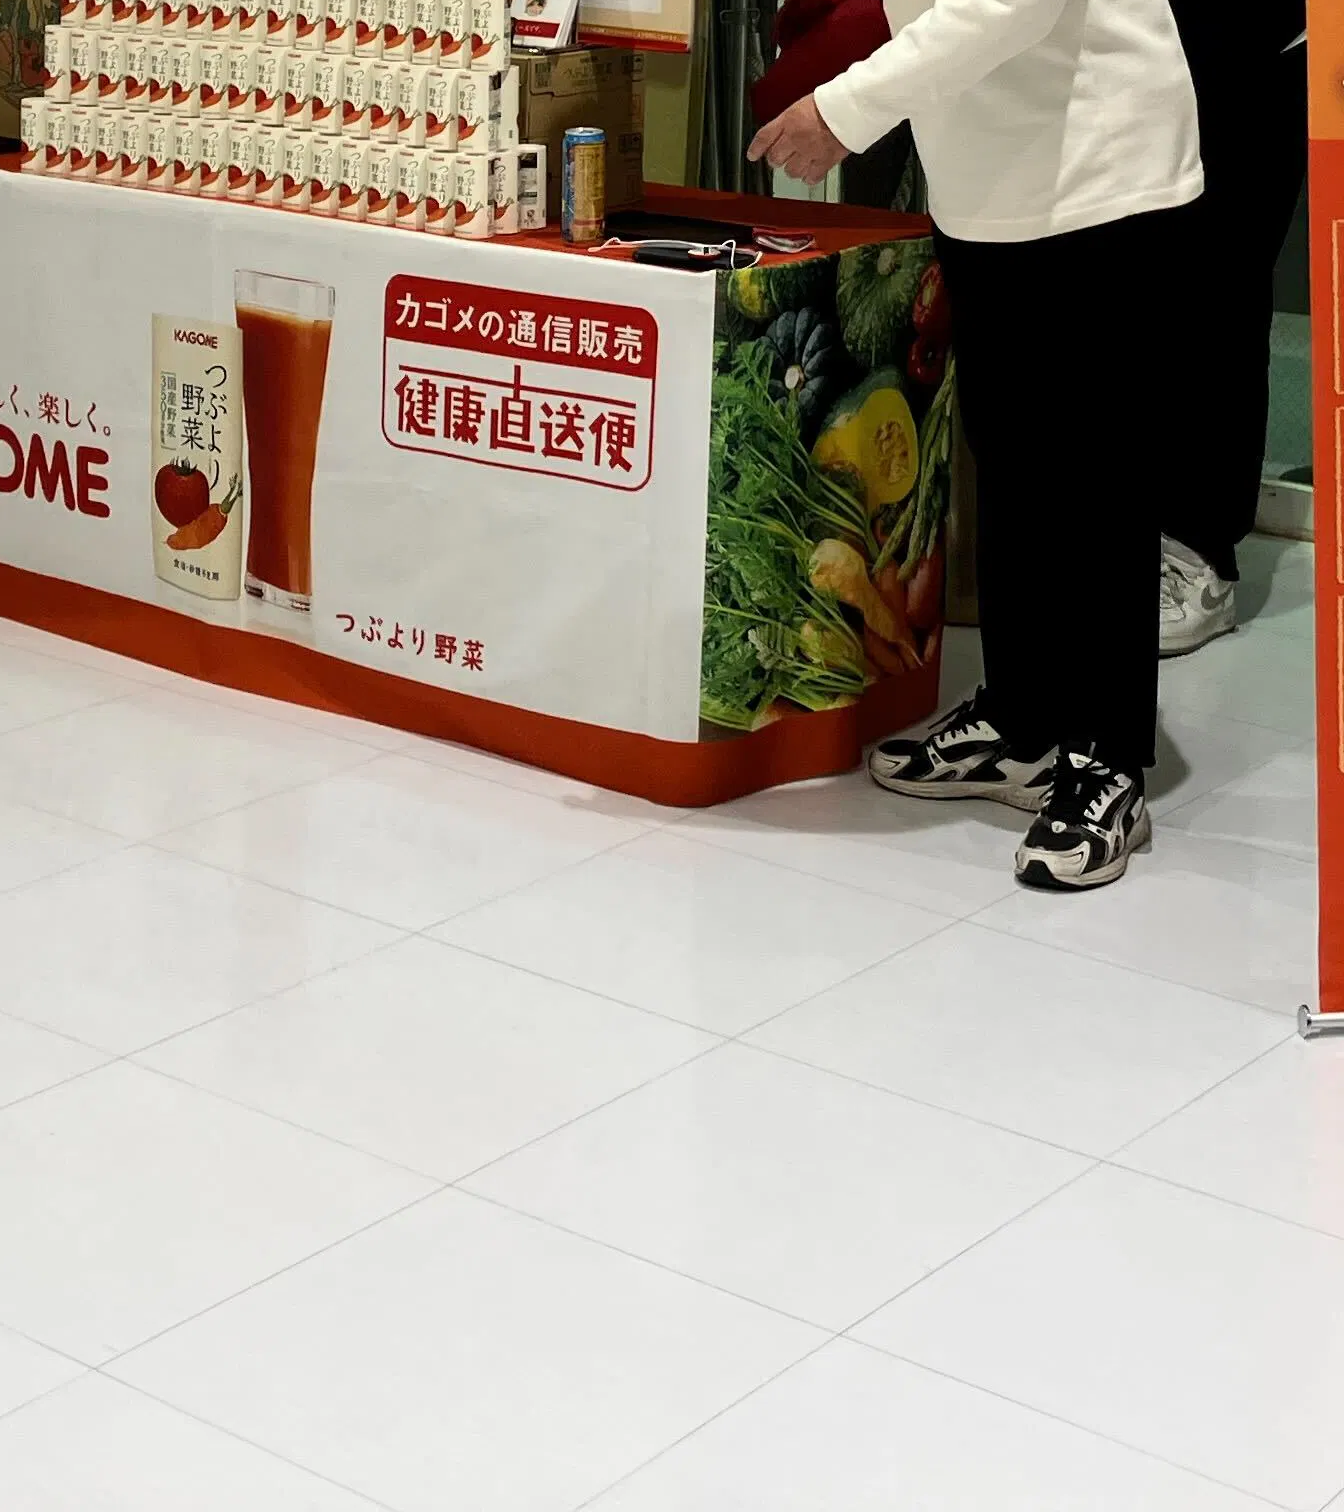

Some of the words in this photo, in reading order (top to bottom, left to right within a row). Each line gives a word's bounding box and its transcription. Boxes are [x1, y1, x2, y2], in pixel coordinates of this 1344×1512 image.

[173, 328, 218, 349] KAGOME
[394, 291, 644, 364] カゴメの通信販売
[181, 383, 205, 451] 野菜
[205, 364, 227, 491] つぶより
[394, 366, 638, 473] 健康直送便
[335, 611, 485, 672] つぶより野菜
